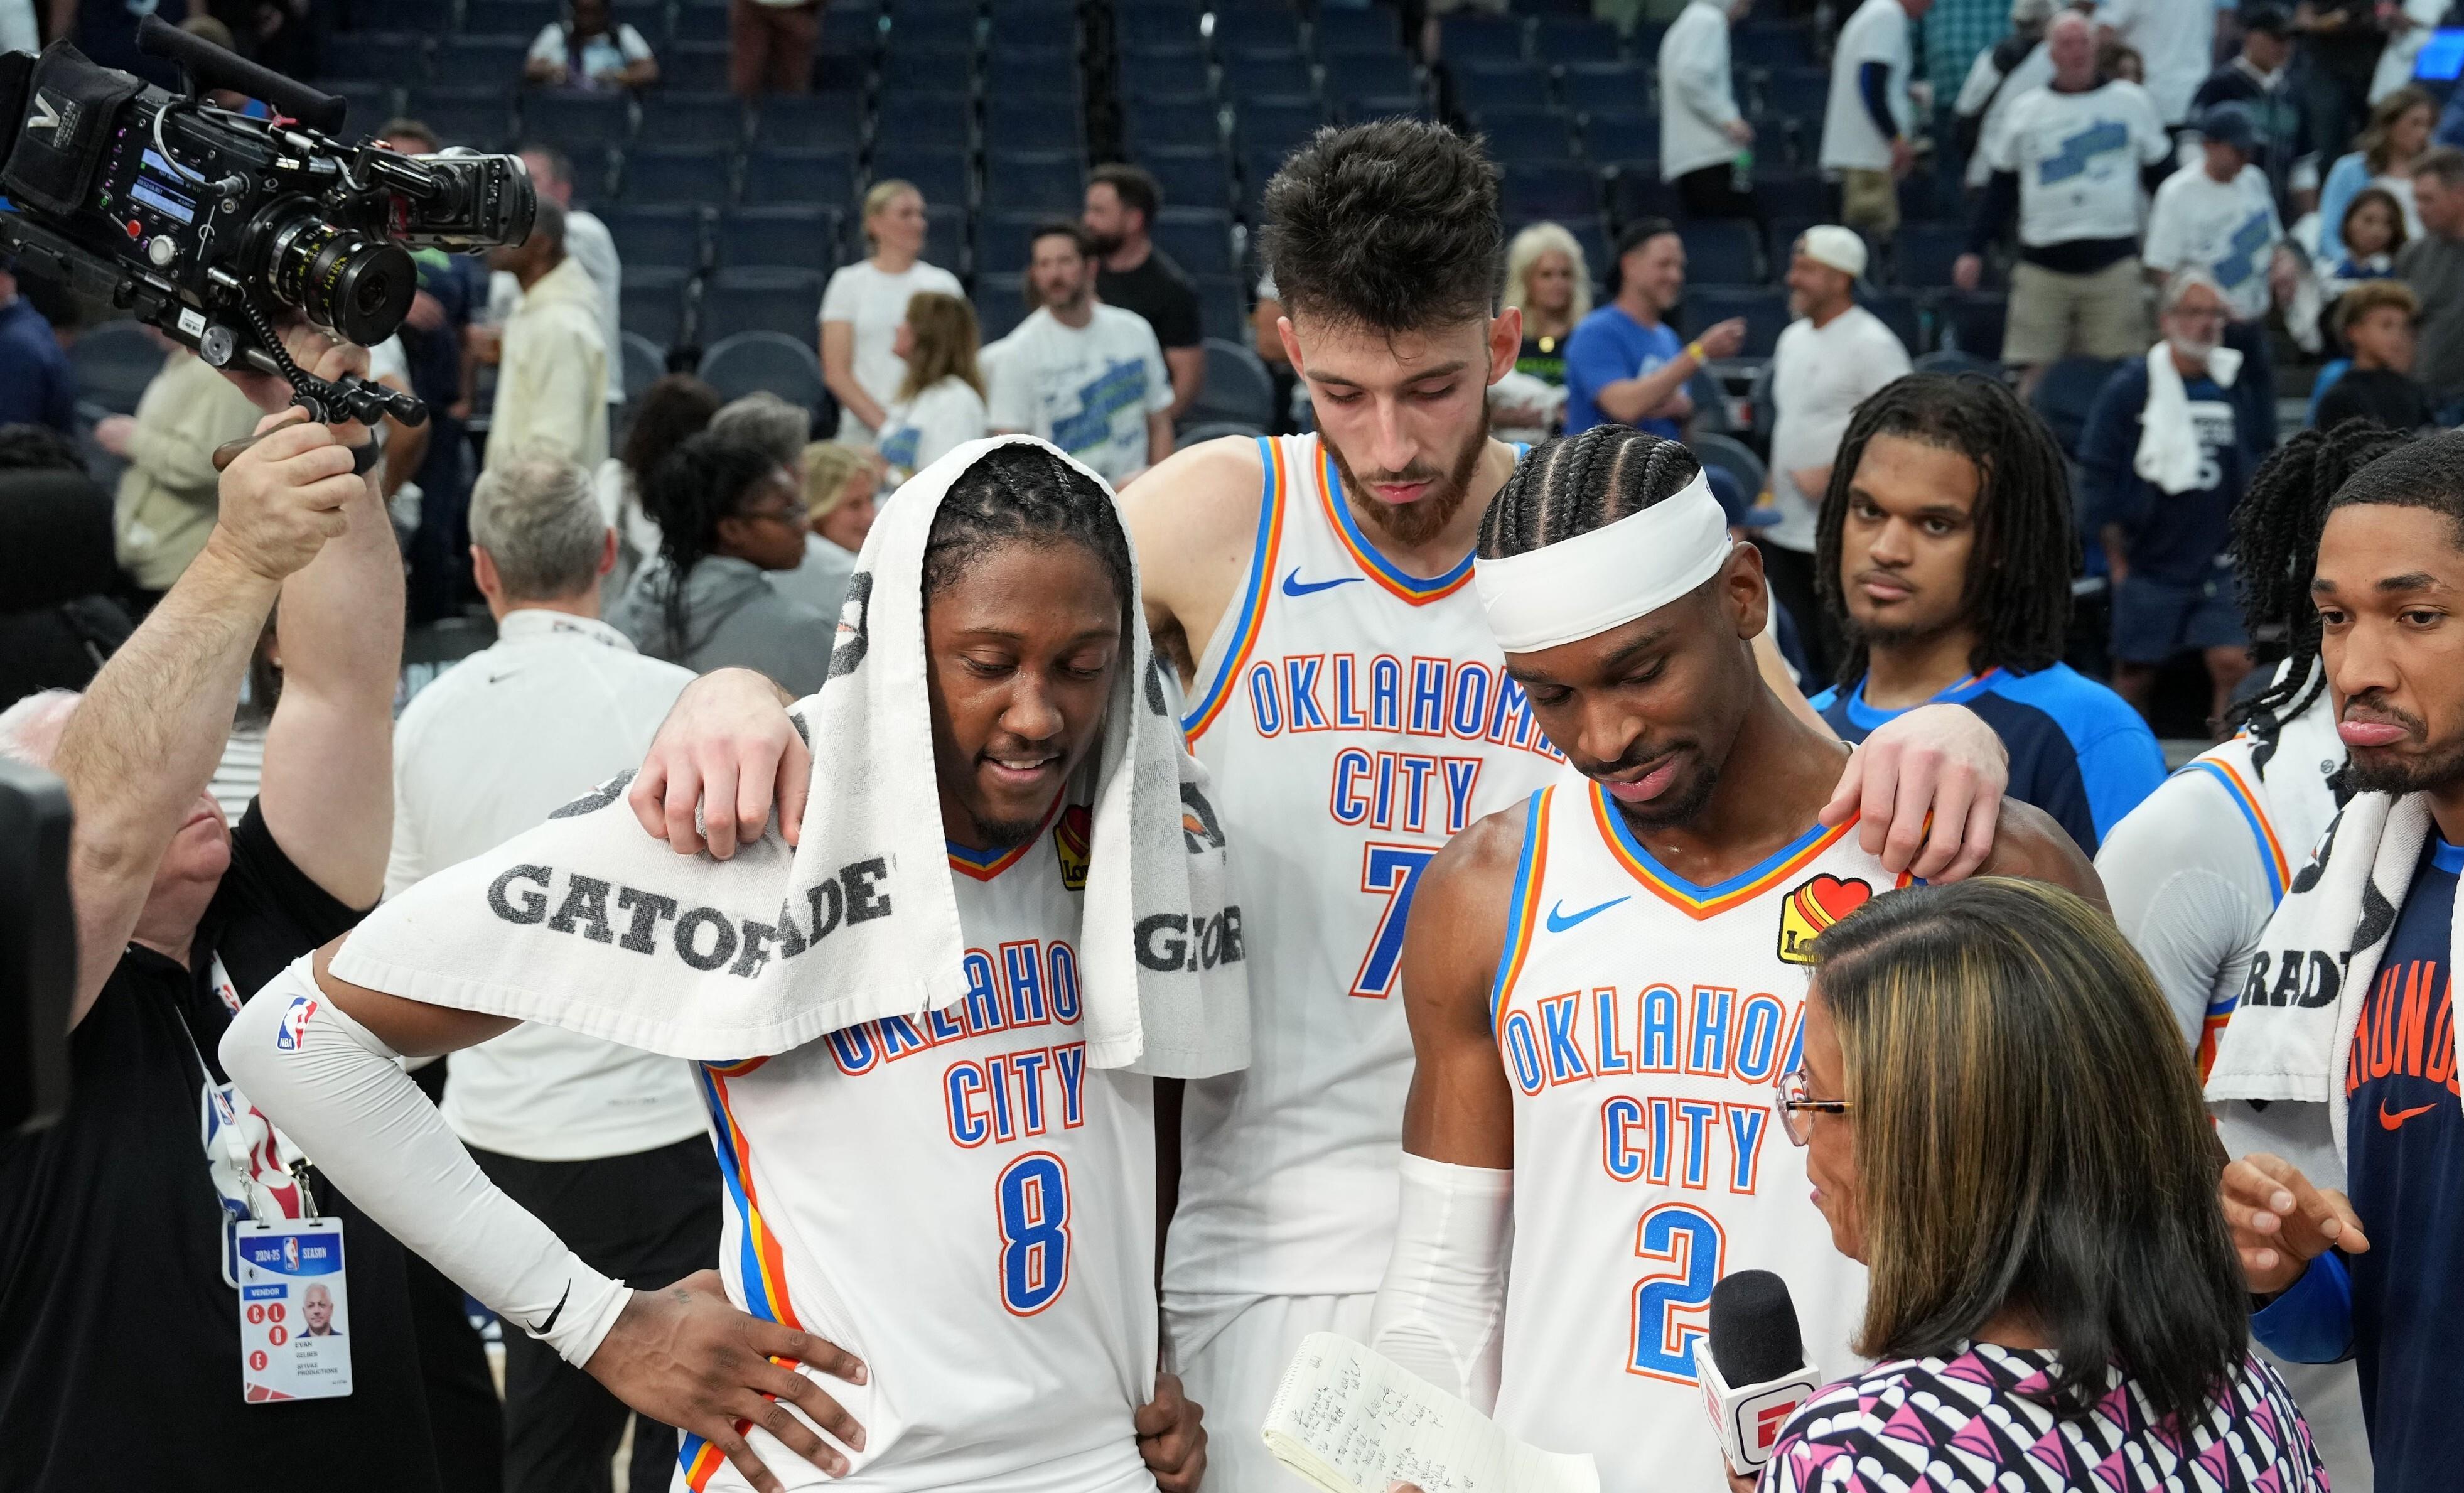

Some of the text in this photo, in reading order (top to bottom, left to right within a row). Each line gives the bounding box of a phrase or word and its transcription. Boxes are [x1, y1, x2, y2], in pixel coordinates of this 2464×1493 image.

[1248, 654, 1567, 765] OKLAHOM
[1330, 746, 1483, 835] CITY
[1349, 841, 1443, 1000] 7
[279, 1037, 293, 1048] NBA
[943, 1040, 1087, 1149] CITY
[1601, 1095, 1770, 1195] CITY
[256, 1247, 326, 1262] 2024-25 SEASON
[996, 1151, 1071, 1317] 8
[251, 1288, 280, 1296] VENDOR
[274, 1305, 280, 1320] L
[1625, 1202, 1726, 1387] 2
[256, 1353, 262, 1368] E
[297, 1367, 338, 1376] PRODUCTIONS
